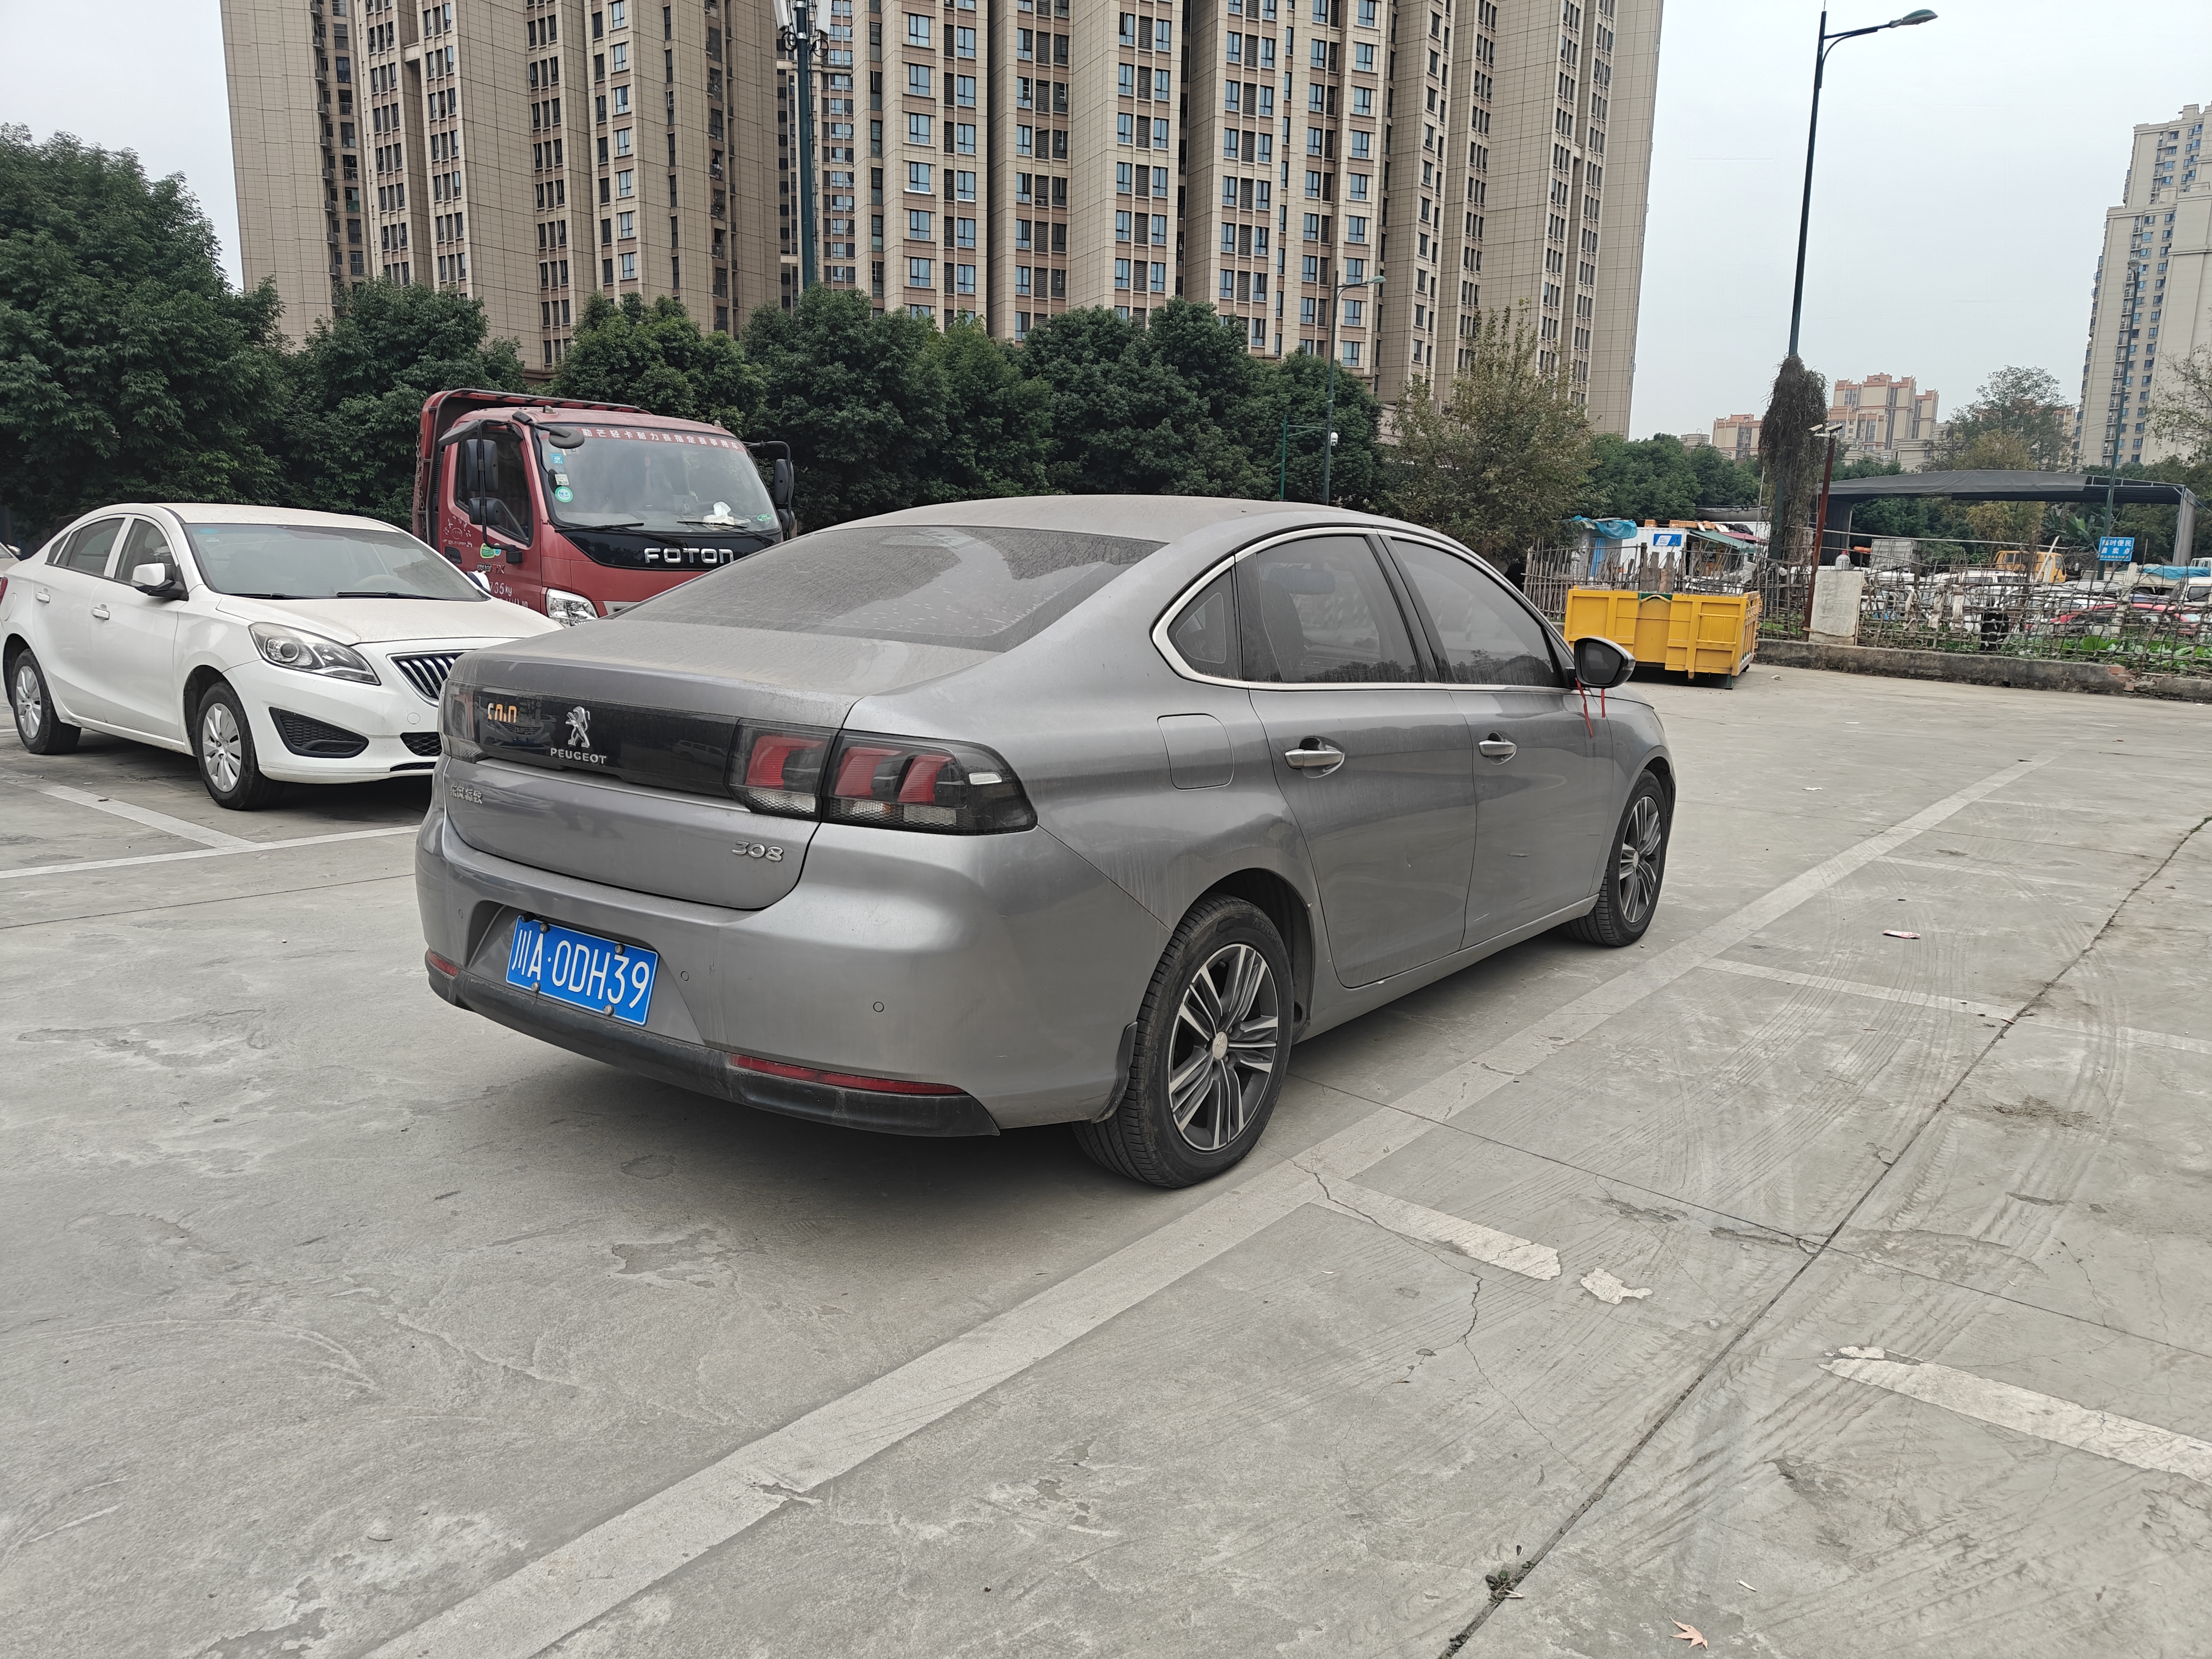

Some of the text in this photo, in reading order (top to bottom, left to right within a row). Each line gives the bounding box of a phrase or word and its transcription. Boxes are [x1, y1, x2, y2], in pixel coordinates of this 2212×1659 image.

[644, 548, 734, 563] FOTON
[550, 747, 606, 764] PEUGEOT
[450, 784, 482, 804] 东风标致
[732, 840, 783, 861] 308
